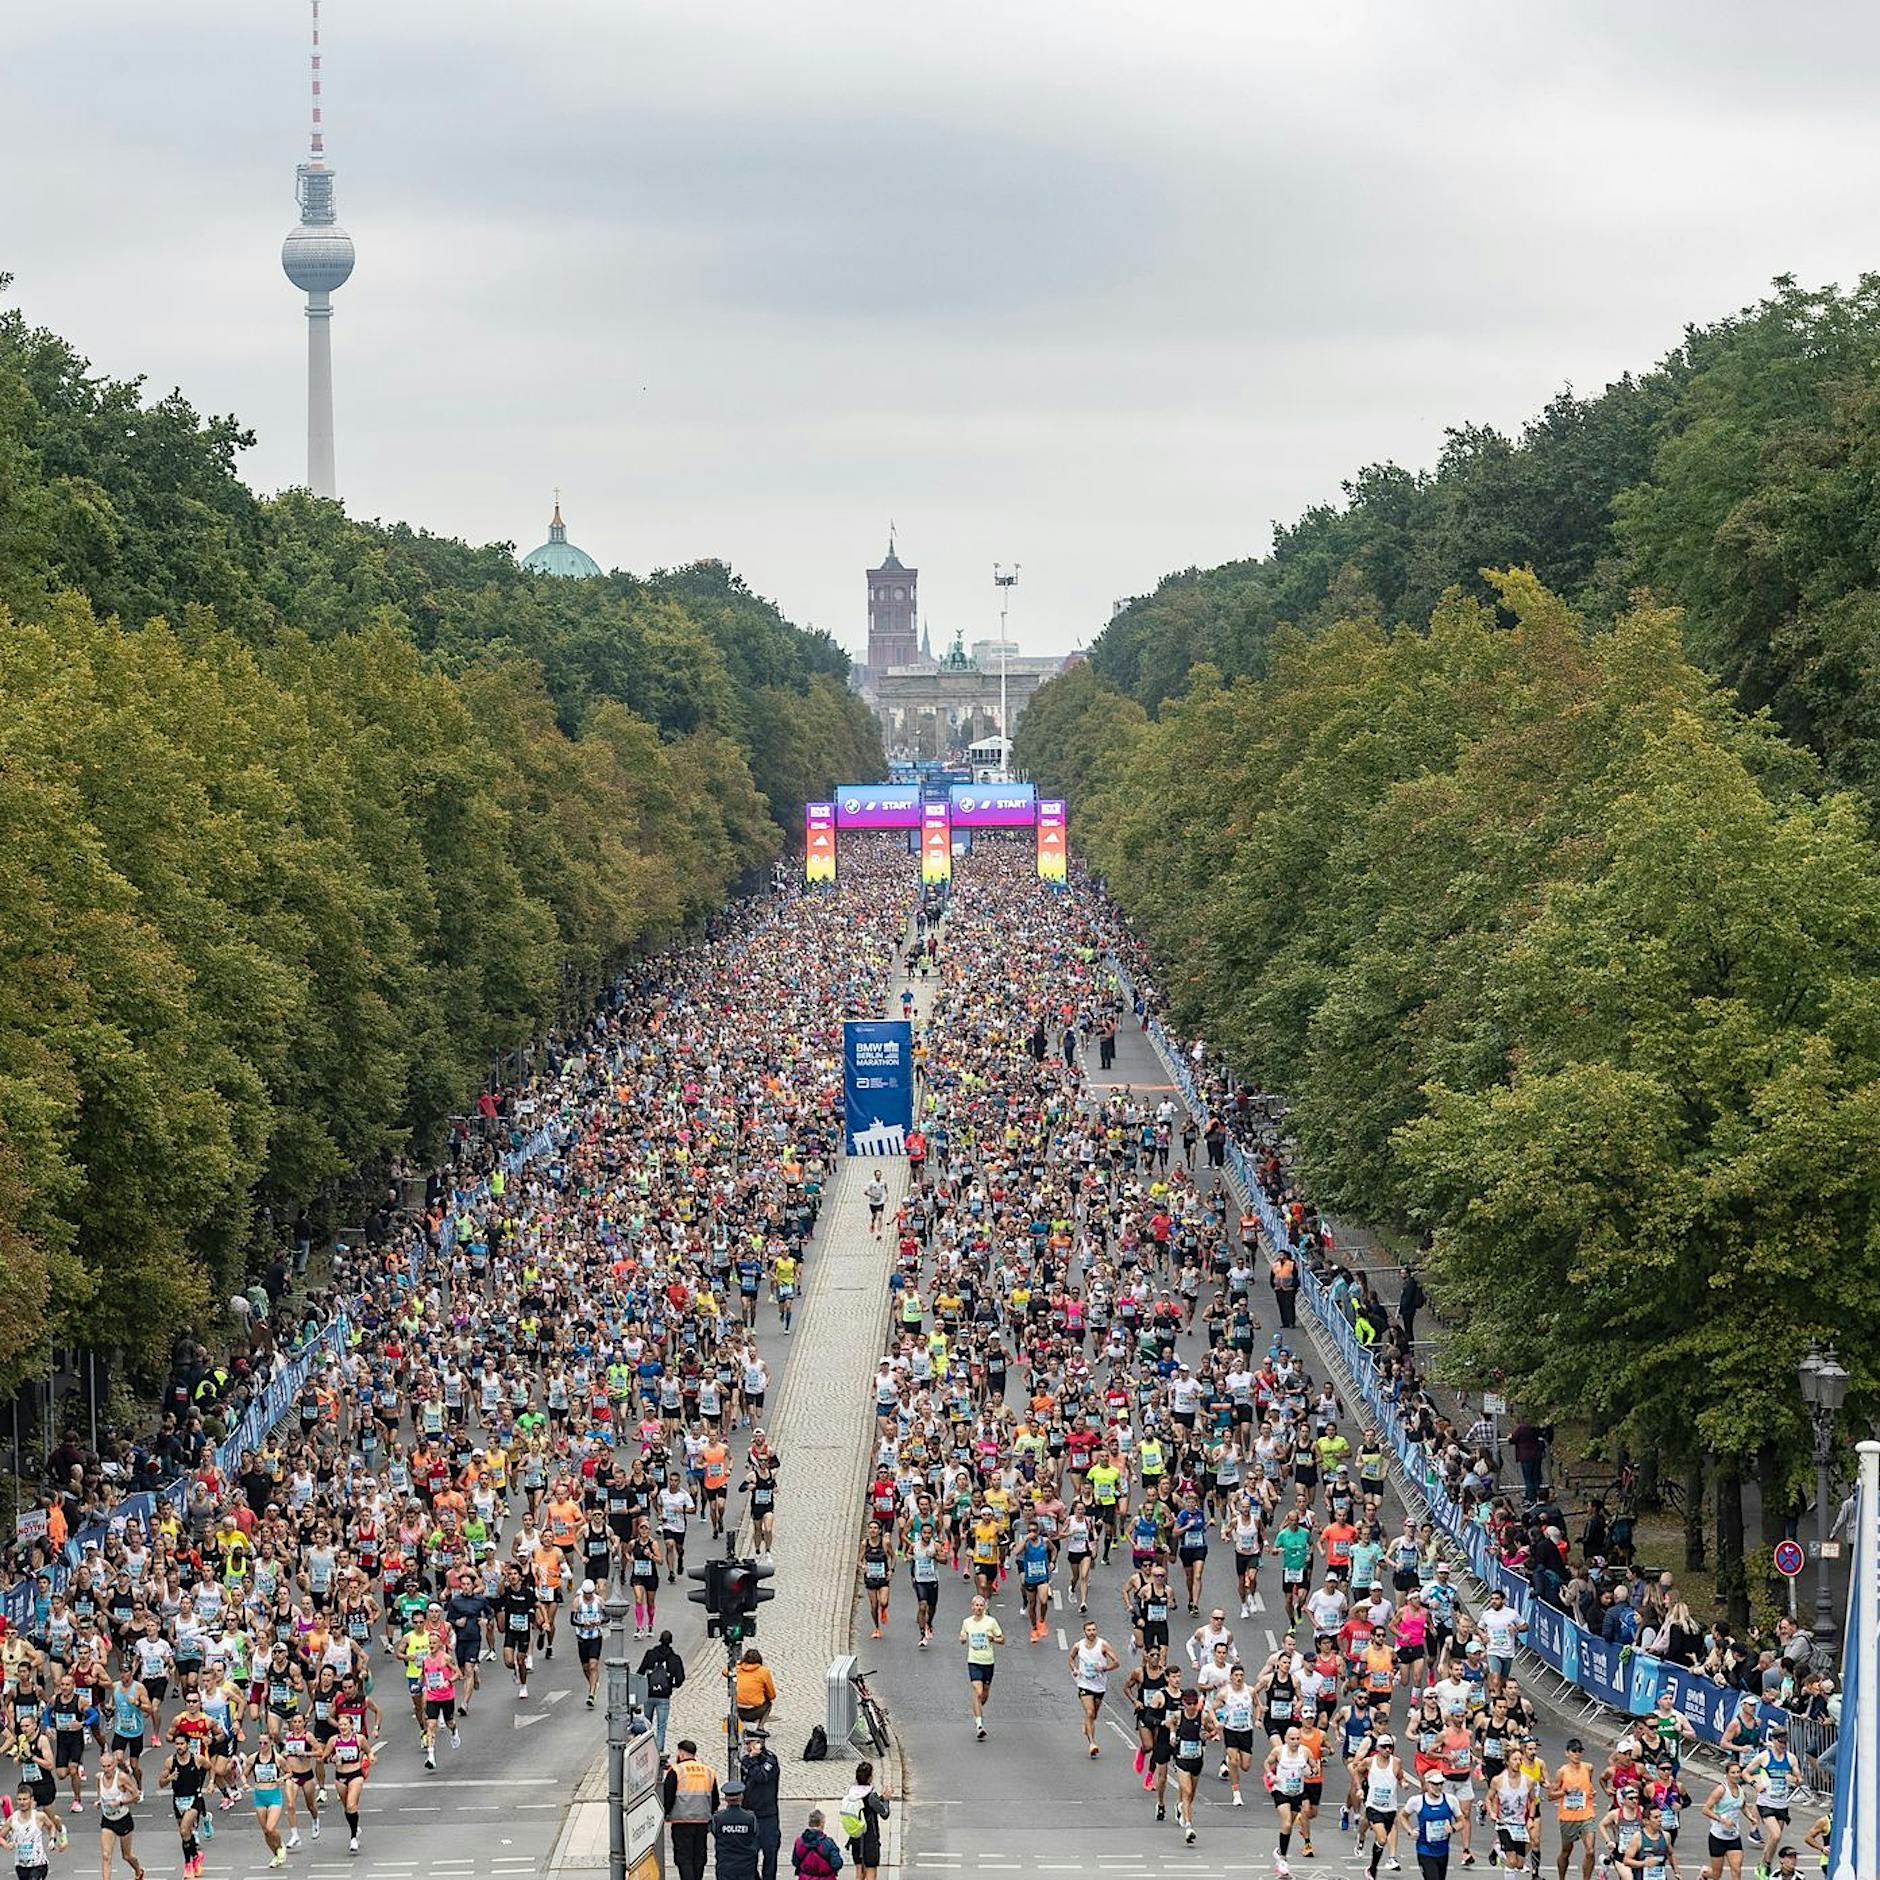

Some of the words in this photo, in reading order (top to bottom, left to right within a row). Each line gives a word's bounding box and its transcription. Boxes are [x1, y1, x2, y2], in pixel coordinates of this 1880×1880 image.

[882, 801, 912, 811] START
[997, 799, 1027, 809] START
[856, 1042, 882, 1052] BMW
[721, 1825, 749, 1834] POLIZEI
